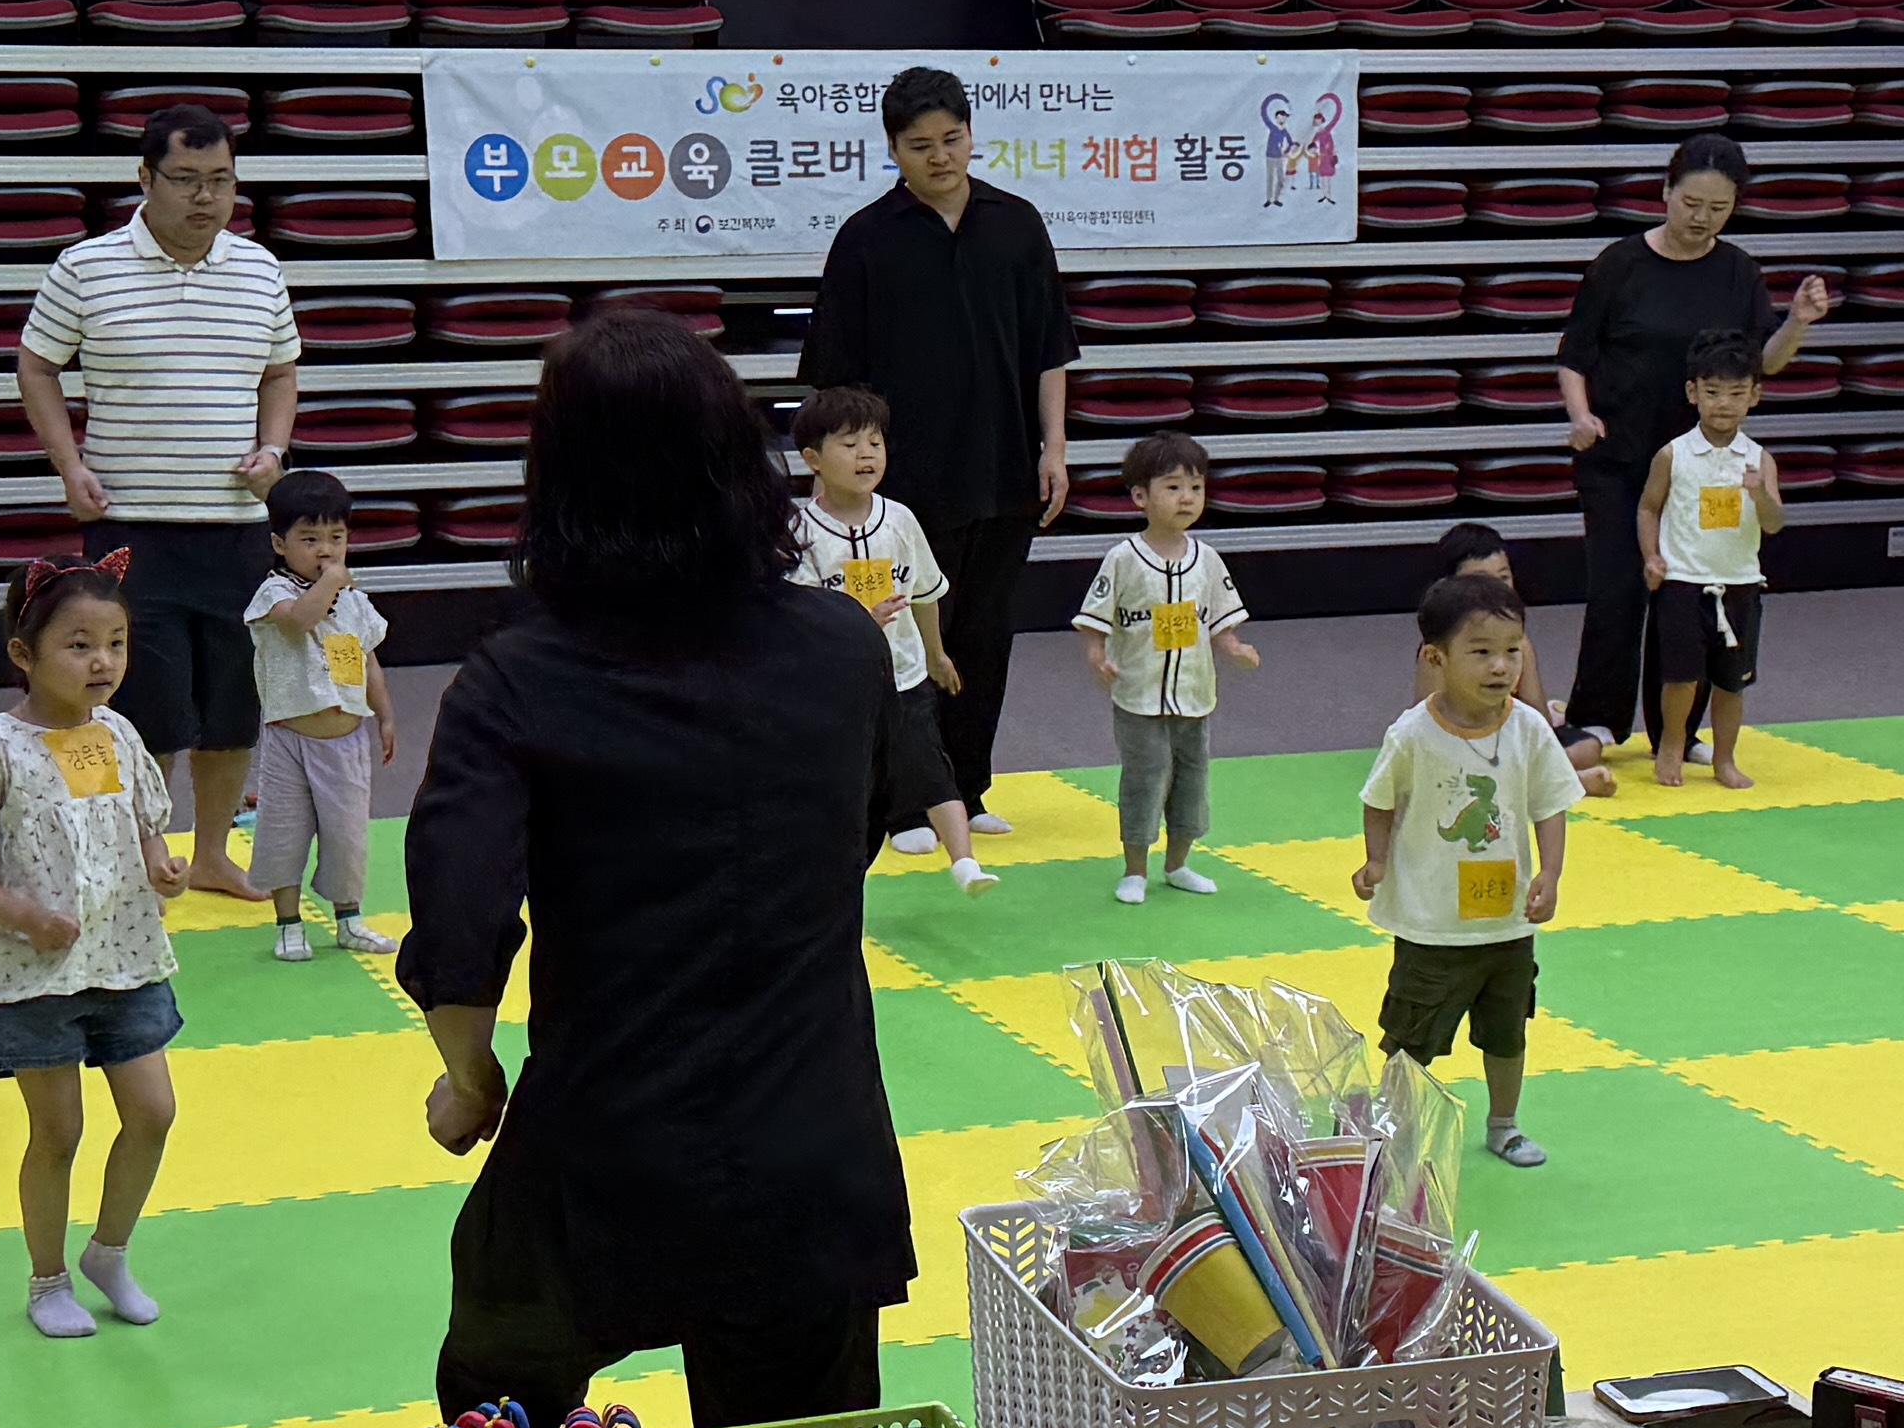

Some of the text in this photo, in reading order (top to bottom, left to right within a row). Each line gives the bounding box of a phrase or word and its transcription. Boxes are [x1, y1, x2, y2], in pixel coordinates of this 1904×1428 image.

[776, 82, 1115, 113] 육아종합터에서 만나는
[746, 138, 865, 187] 클로버
[1081, 136, 1158, 182] 체험
[1173, 132, 1251, 182] 활동
